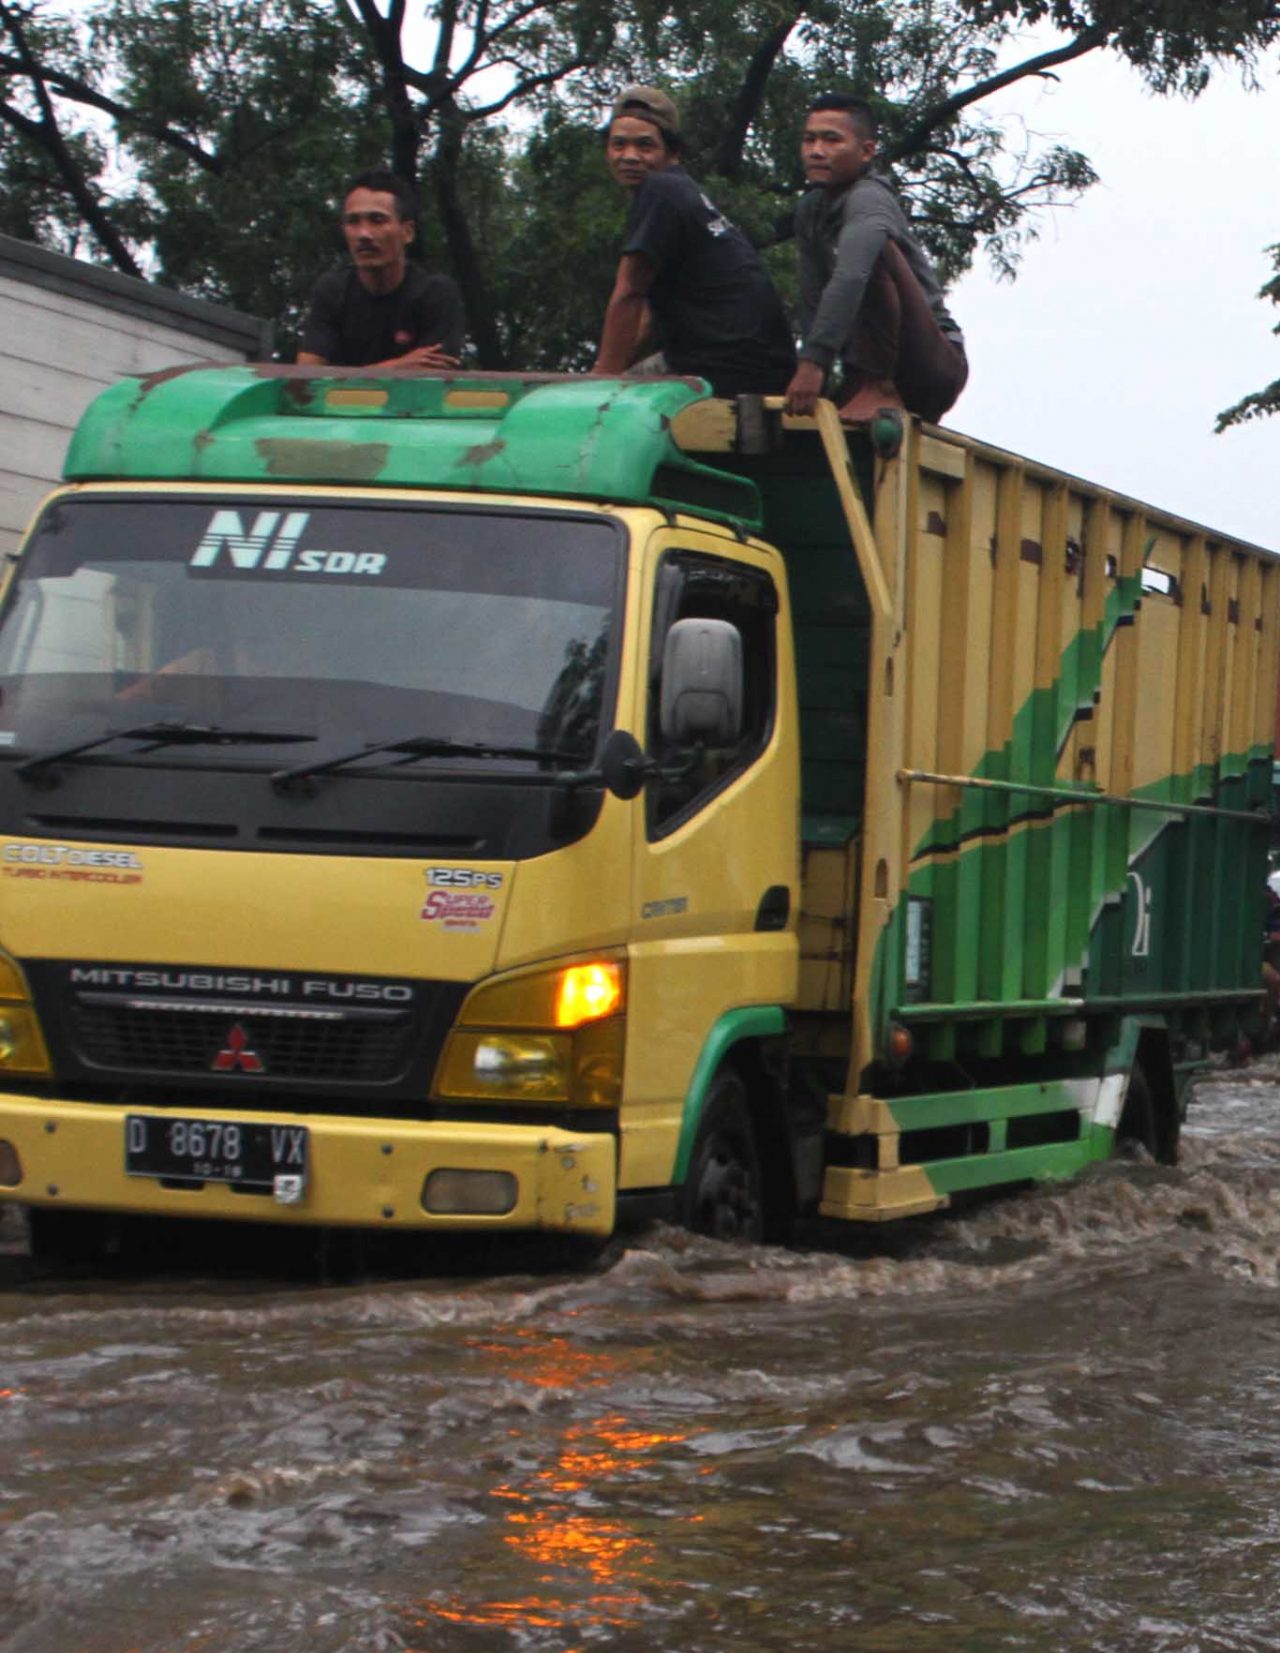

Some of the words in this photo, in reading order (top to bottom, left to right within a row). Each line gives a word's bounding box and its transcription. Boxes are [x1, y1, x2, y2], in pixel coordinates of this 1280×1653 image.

[4, 845, 68, 864] COLT
[67, 849, 144, 868] DIESEL
[70, 968, 291, 994] MITSUBISHI
[303, 980, 413, 1001] FUSO
[128, 1118, 147, 1153] D
[170, 1121, 241, 1160] 8678
[271, 1128, 304, 1164] VX
